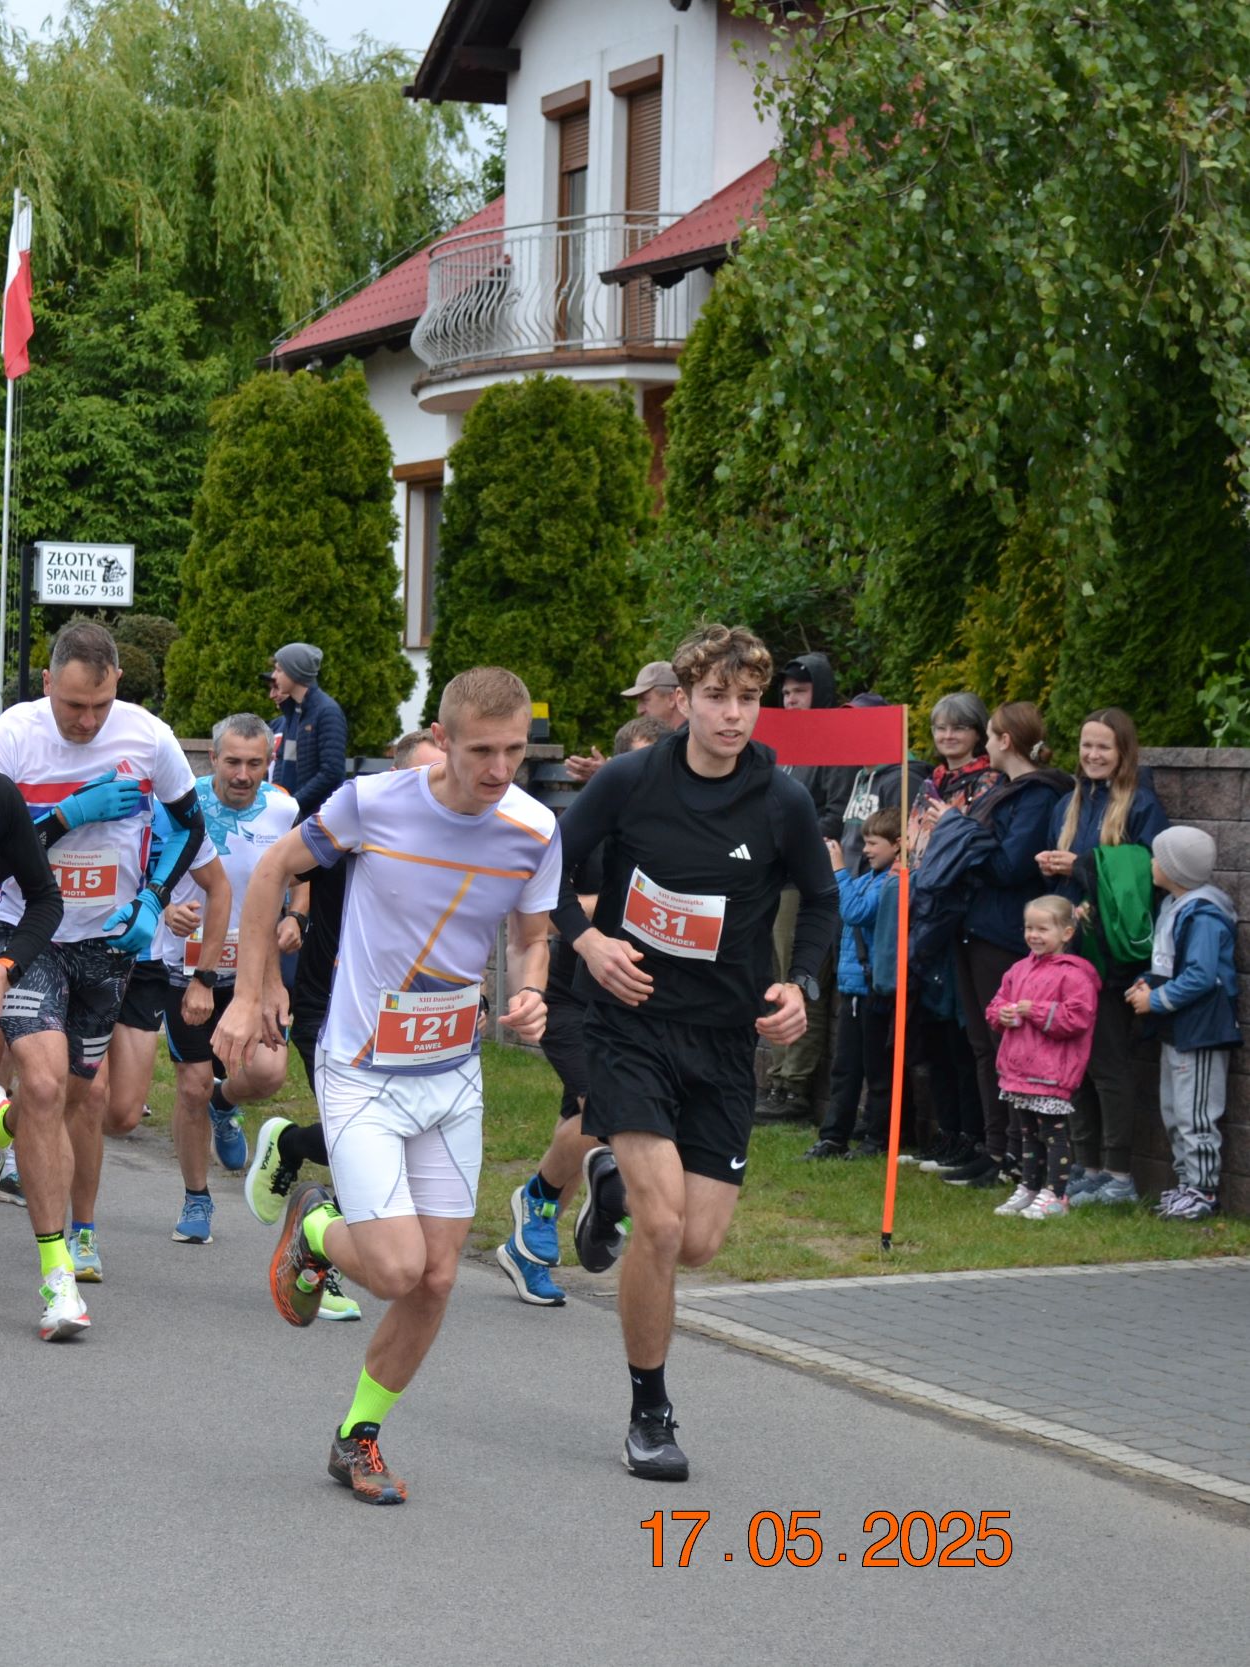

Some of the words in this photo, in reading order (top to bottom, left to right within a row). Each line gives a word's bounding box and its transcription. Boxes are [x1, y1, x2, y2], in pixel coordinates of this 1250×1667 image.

[47, 552, 95, 566] ZŁOTY
[46, 568, 96, 582] SPANIEL
[47, 584, 70, 595] 508
[74, 584, 96, 596] 267
[101, 585, 124, 597] 938
[52, 867, 102, 889] 115
[650, 907, 687, 936] 31
[640, 923, 696, 947] ALEKSANDER
[433, 993, 464, 1003] Dziesiątka
[412, 1004, 455, 1012] Fiedlerowska
[400, 1013, 458, 1042] 121
[413, 1042, 442, 1051] PAWEŁ
[260, 1140, 275, 1171] HOKA
